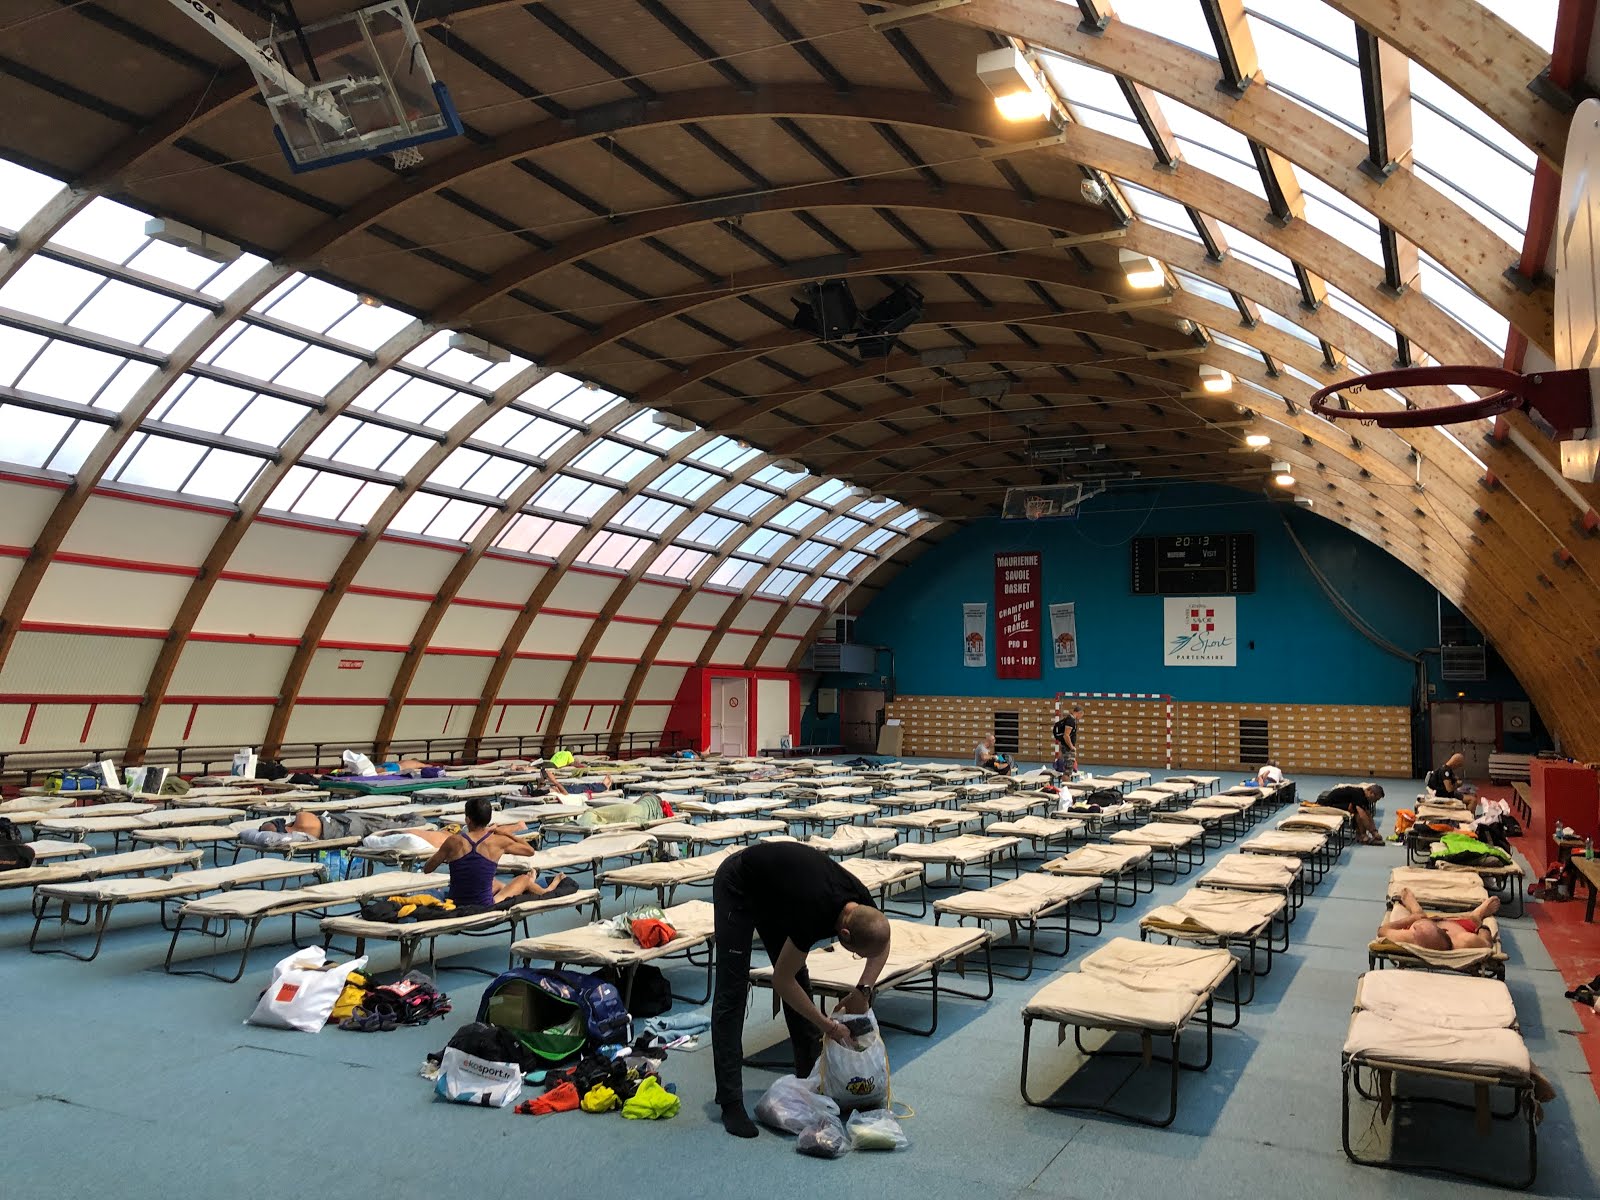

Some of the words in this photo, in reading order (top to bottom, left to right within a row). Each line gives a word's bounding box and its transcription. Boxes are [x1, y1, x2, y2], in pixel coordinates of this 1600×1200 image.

[1176, 536, 1210, 546] 20:13
[997, 556, 1038, 567] MAURIENNE
[1005, 570, 1030, 580] SAVOIE
[1004, 583, 1030, 594] BASKET
[998, 599, 1035, 619] CHAMPION
[1013, 612, 1022, 623] DE
[1004, 620, 1029, 634] FRANCE
[1008, 640, 1021, 649] PRO
[1190, 630, 1234, 654] Sport
[463, 1058, 511, 1080] ekosport.fr
